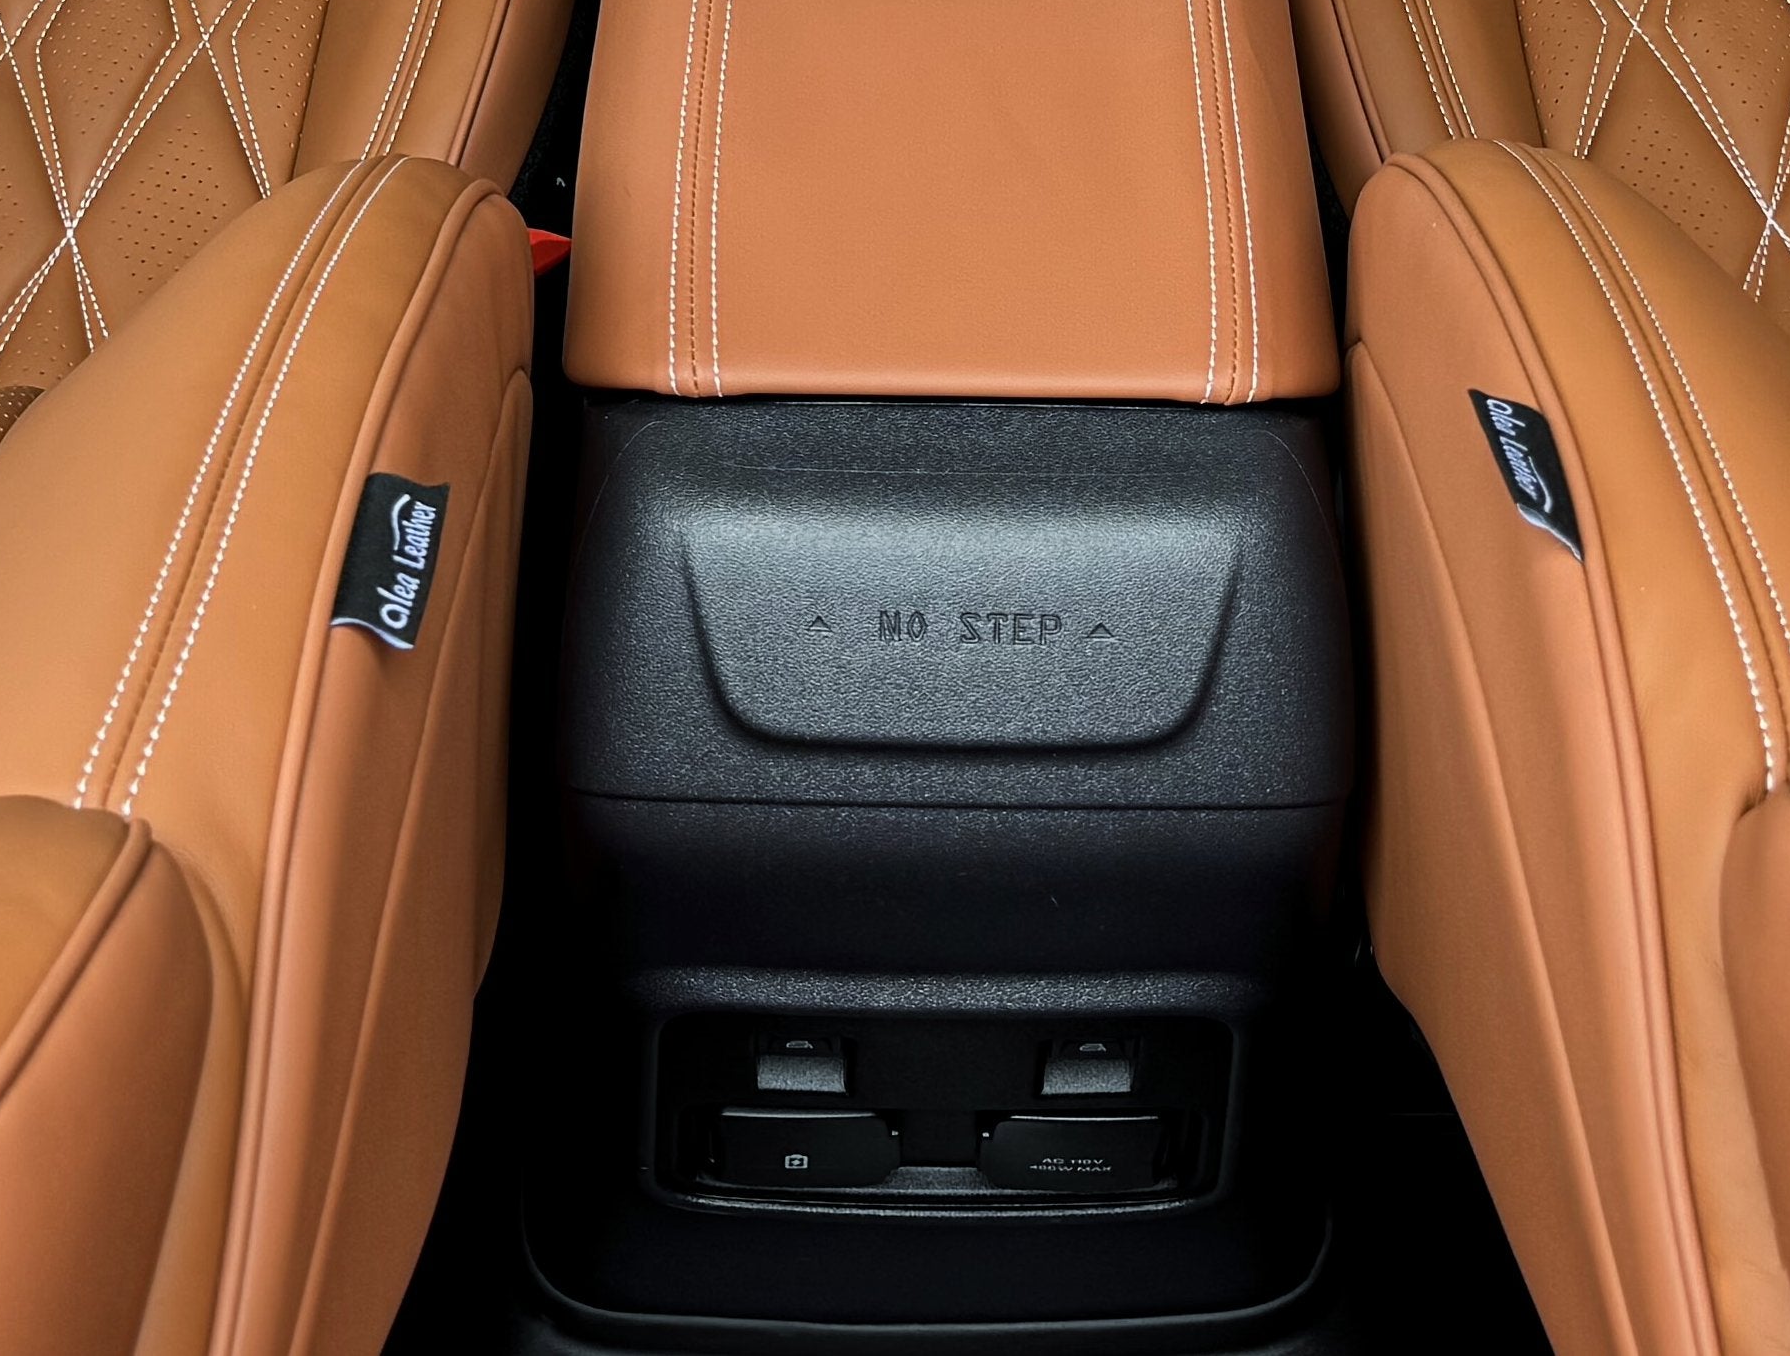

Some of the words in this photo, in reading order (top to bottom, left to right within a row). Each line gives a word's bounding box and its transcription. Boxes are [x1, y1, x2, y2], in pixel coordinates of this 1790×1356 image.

[391, 500, 436, 570] Leather
[375, 572, 420, 629] Olea
[878, 610, 928, 643] NO
[959, 612, 1064, 646] STEP
